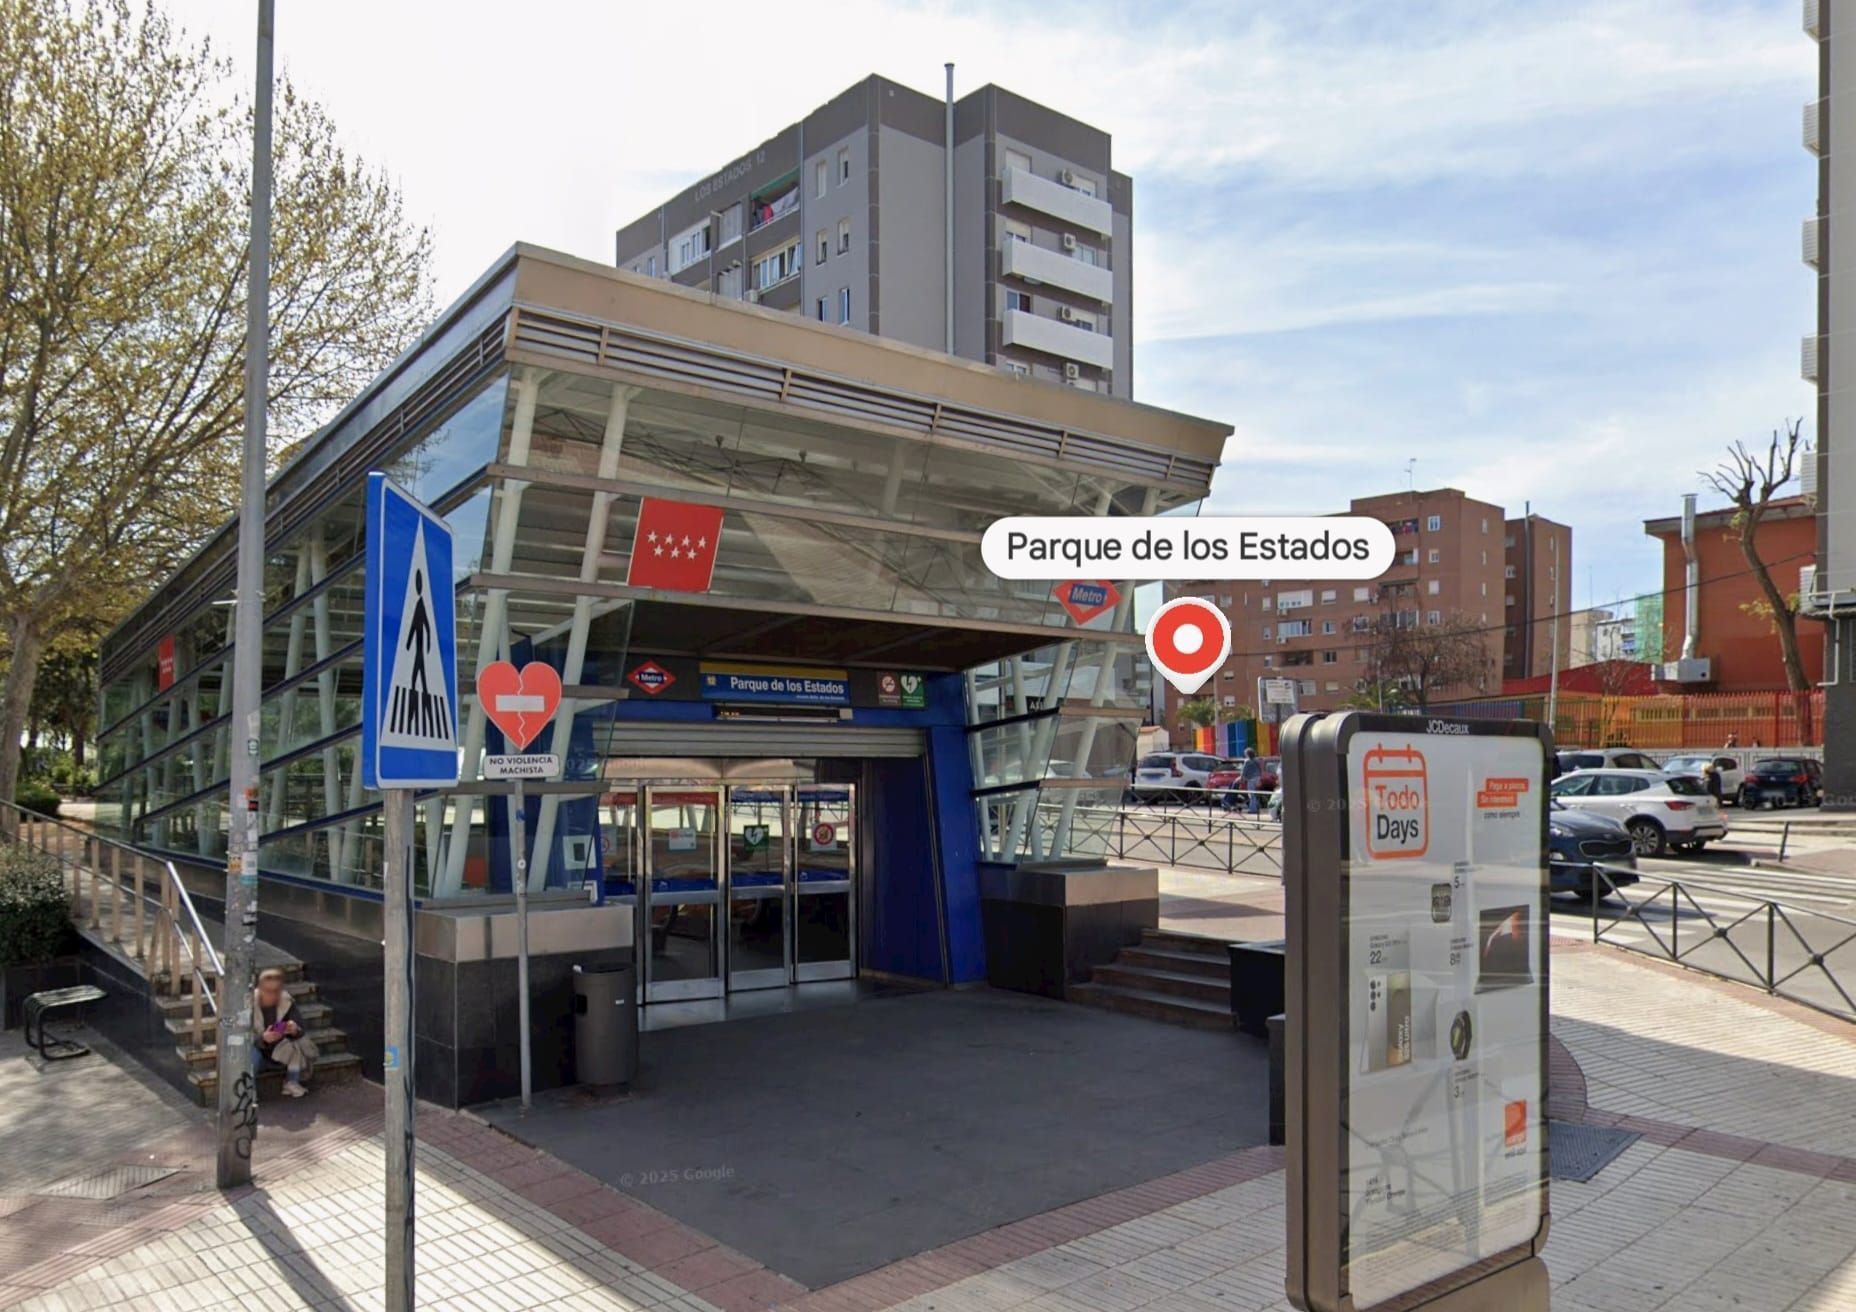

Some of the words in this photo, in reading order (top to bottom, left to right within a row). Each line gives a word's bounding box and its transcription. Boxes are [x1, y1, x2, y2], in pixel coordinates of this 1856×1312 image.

[695, 183, 712, 203] LOS
[712, 158, 752, 192] ESTADOS
[1072, 586, 1102, 603] Metro
[640, 674, 662, 682] Metro
[730, 676, 768, 693] Parque
[771, 679, 784, 691] de
[787, 680, 802, 692] los
[804, 680, 845, 694] Estados
[1426, 720, 1470, 734] JCDecaux
[489, 757, 504, 765] NO
[507, 756, 553, 765] VIOLENCIA
[499, 766, 544, 774] MACHISTA
[1375, 785, 1420, 810] Todo
[1377, 814, 1419, 845] Days
